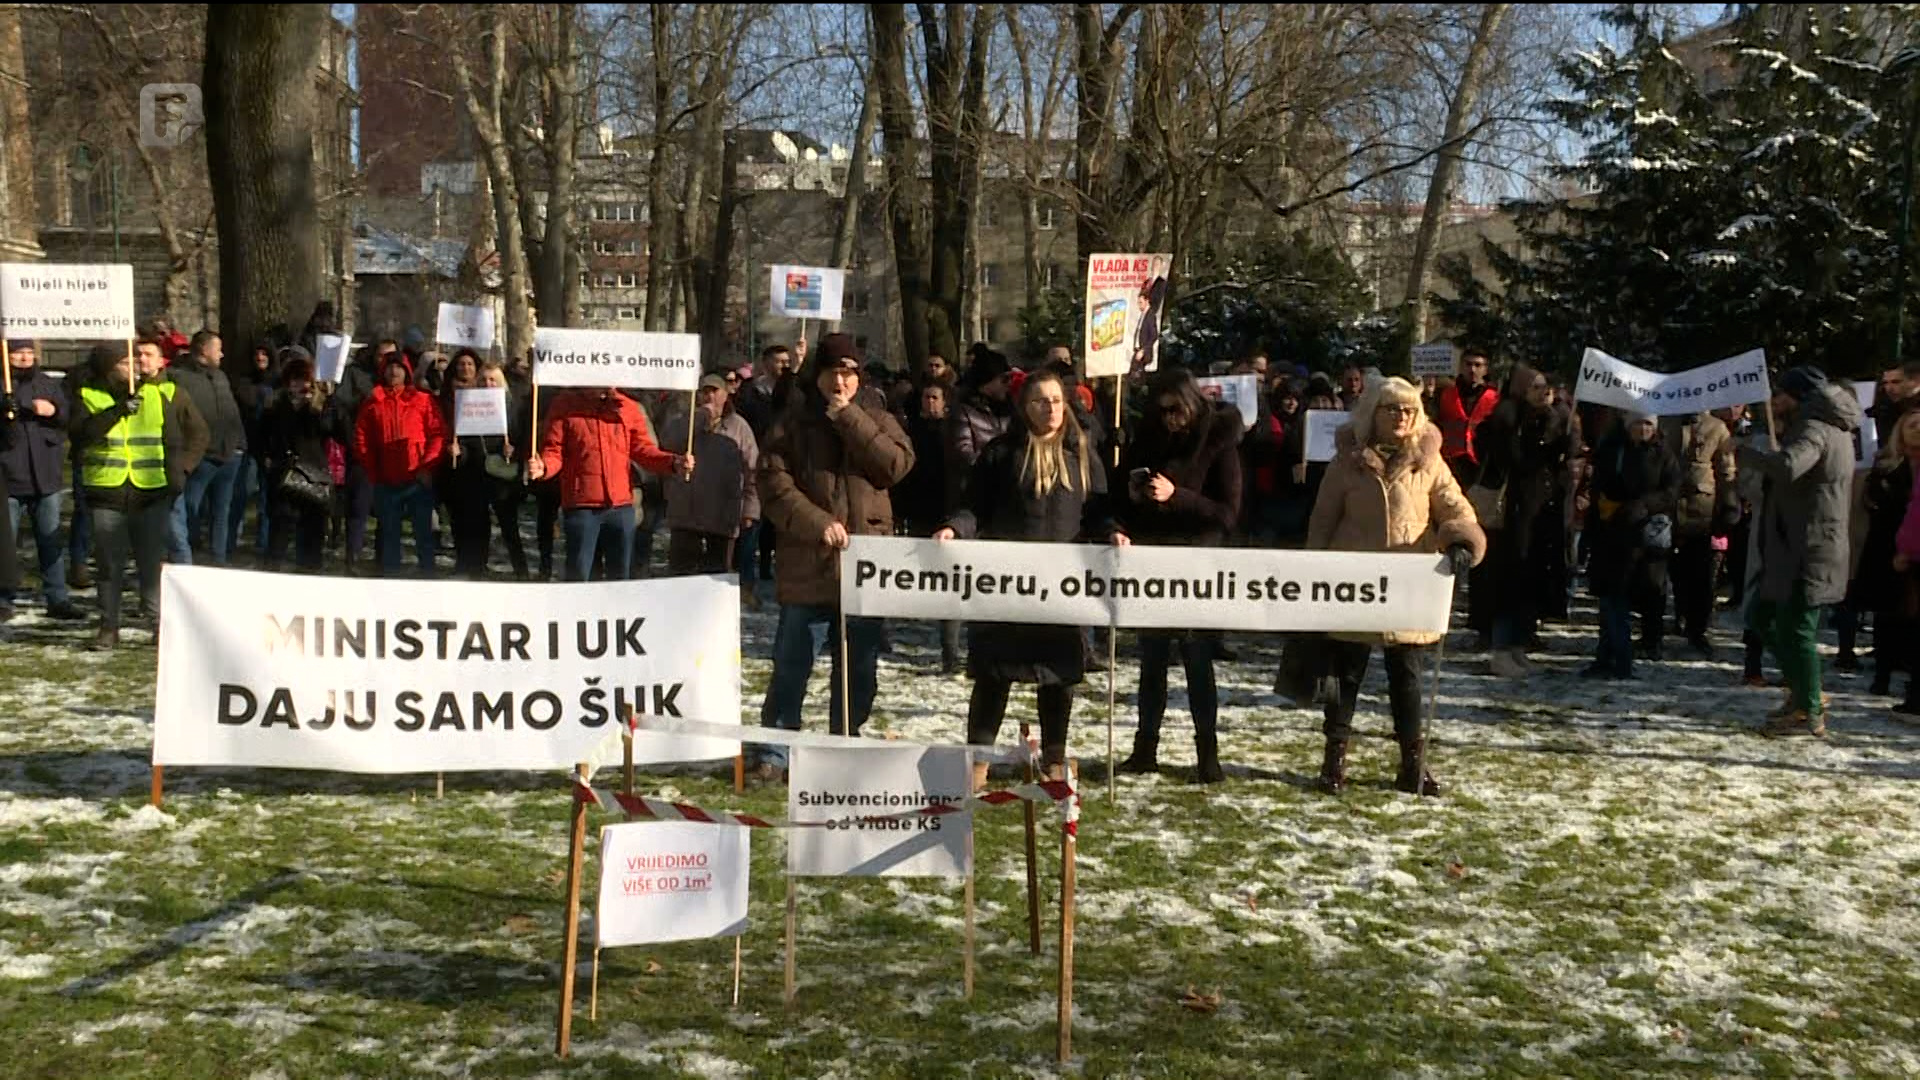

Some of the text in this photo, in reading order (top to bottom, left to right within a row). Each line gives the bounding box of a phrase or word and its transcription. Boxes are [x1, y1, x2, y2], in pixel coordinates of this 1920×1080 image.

[1092, 259, 1149, 273] VLADA KS
[20, 278, 108, 293] Bijeli hljeb
[42, 315, 130, 331] subvencija
[536, 350, 586, 365] Vlada
[590, 352, 611, 367] KS
[627, 355, 696, 369] obmana
[1583, 366, 1661, 401] Vrijedimo
[1665, 386, 1703, 401] više
[1706, 375, 1730, 393] od
[855, 559, 1389, 603] Premijeru, obmanuli ste nas!
[265, 614, 647, 661] MINISTAR I UK
[217, 676, 685, 732] DAJU SAMO ŠUK
[825, 816, 850, 831] od
[918, 816, 942, 832] KS
[626, 852, 708, 871] VRIJEDIMO
[622, 873, 653, 893] VIŠE
[657, 875, 680, 891] OD
